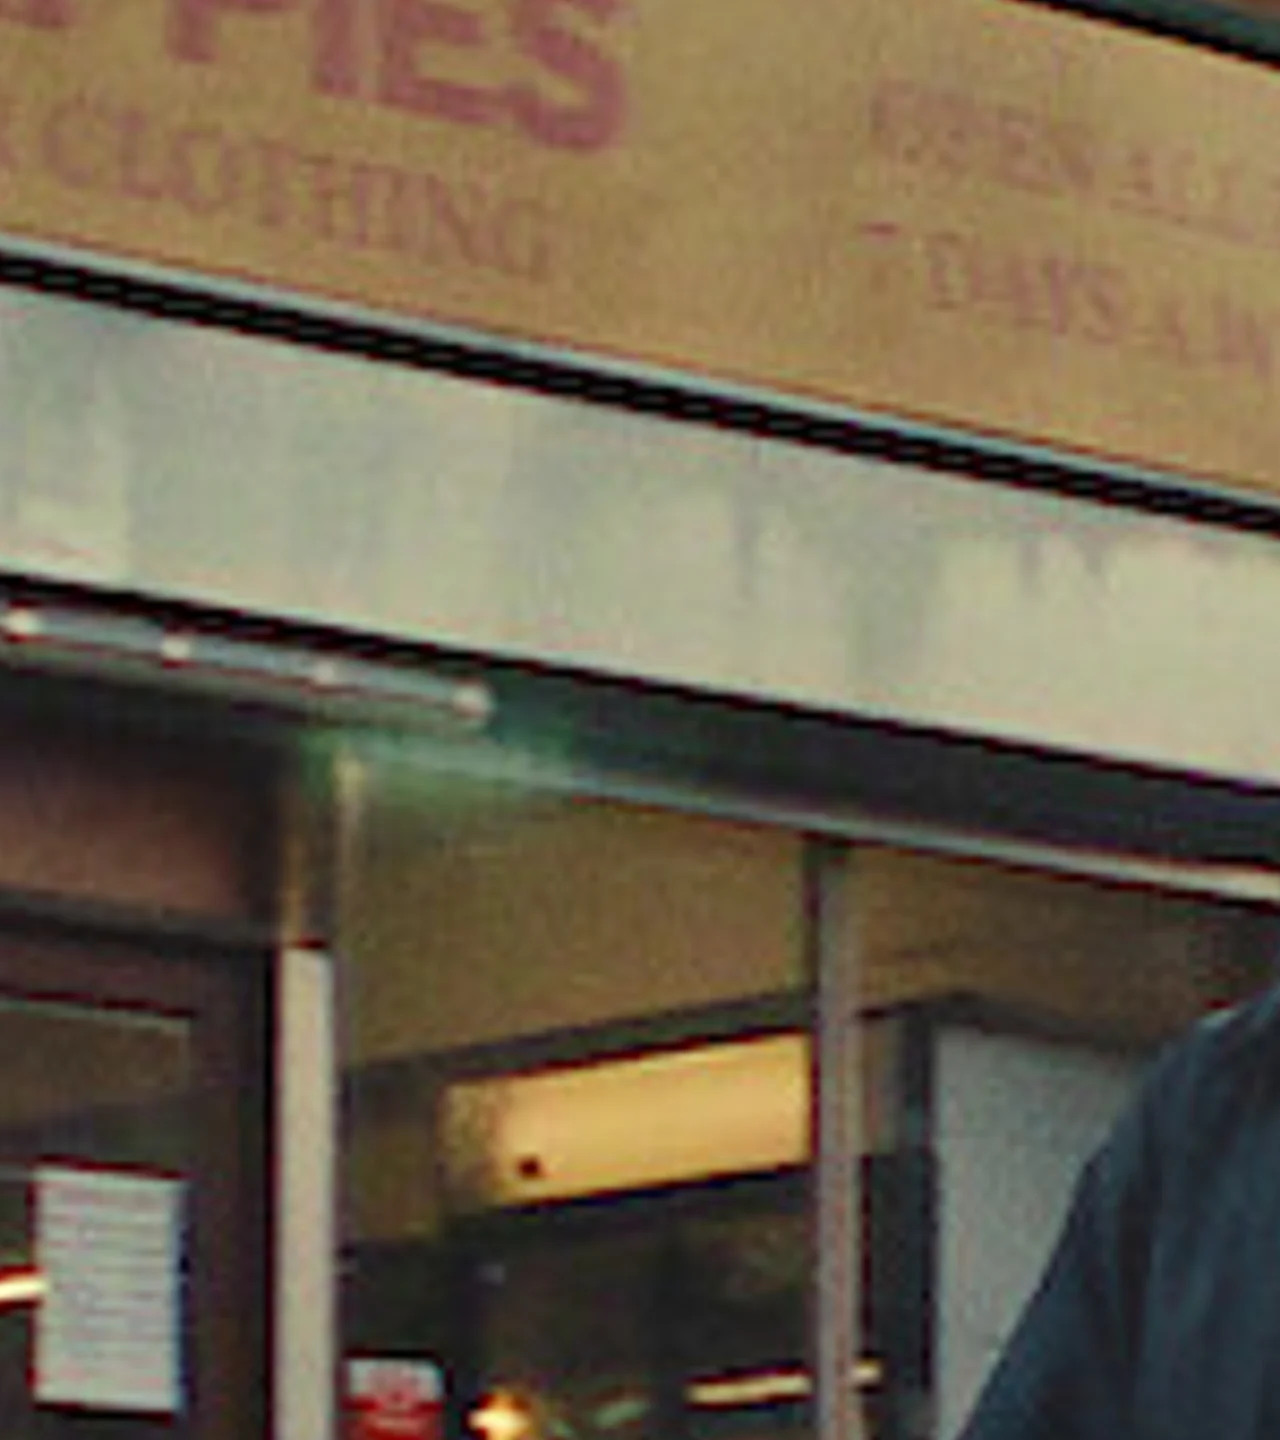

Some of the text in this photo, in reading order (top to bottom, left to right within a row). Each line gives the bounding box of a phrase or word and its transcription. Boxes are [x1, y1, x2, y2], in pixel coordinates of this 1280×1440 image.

[38, 91, 555, 286] CLOTHING
[868, 76, 1098, 194] OPEN
[1110, 144, 1254, 245] ALL
[926, 227, 1126, 346] DAYS
[1144, 295, 1194, 370] A
